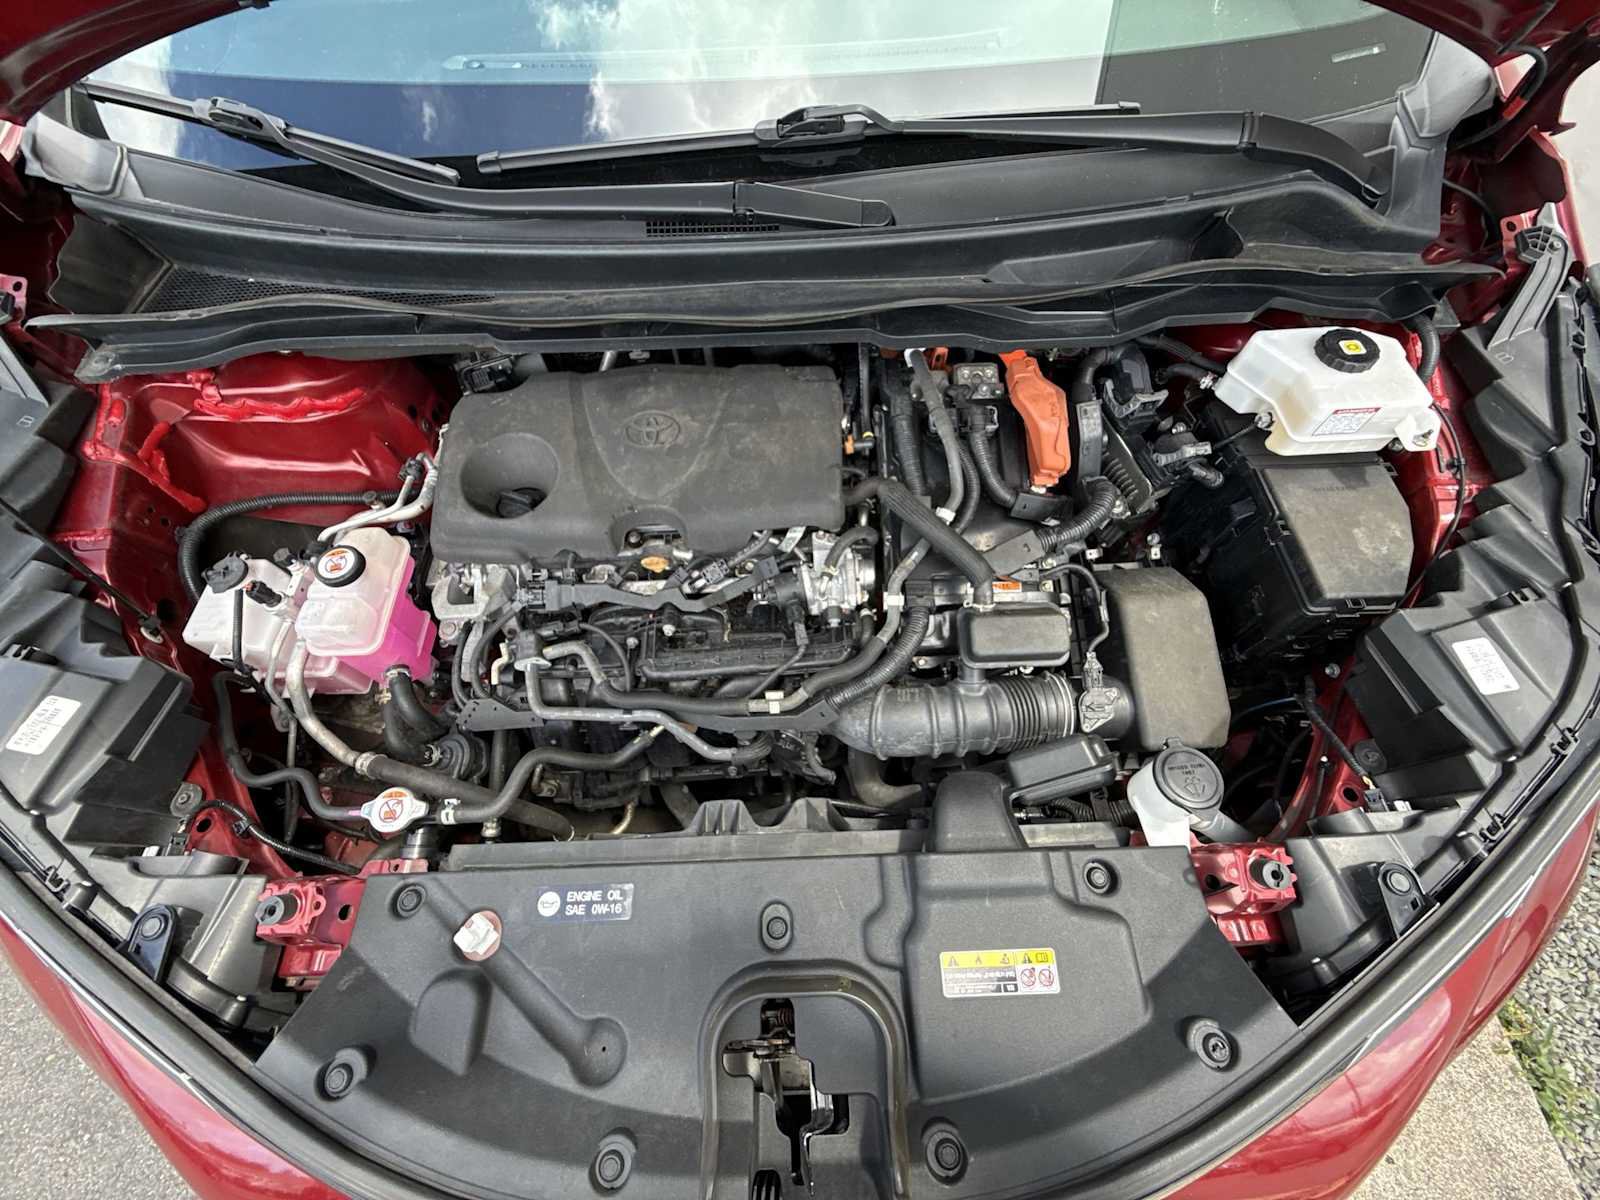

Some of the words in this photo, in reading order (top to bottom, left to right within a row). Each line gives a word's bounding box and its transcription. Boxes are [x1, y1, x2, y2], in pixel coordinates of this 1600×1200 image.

[566, 890, 602, 902] ENGINE
[607, 889, 623, 901] OIL
[565, 904, 586, 916] SAE
[591, 903, 622, 915] 0W-16
